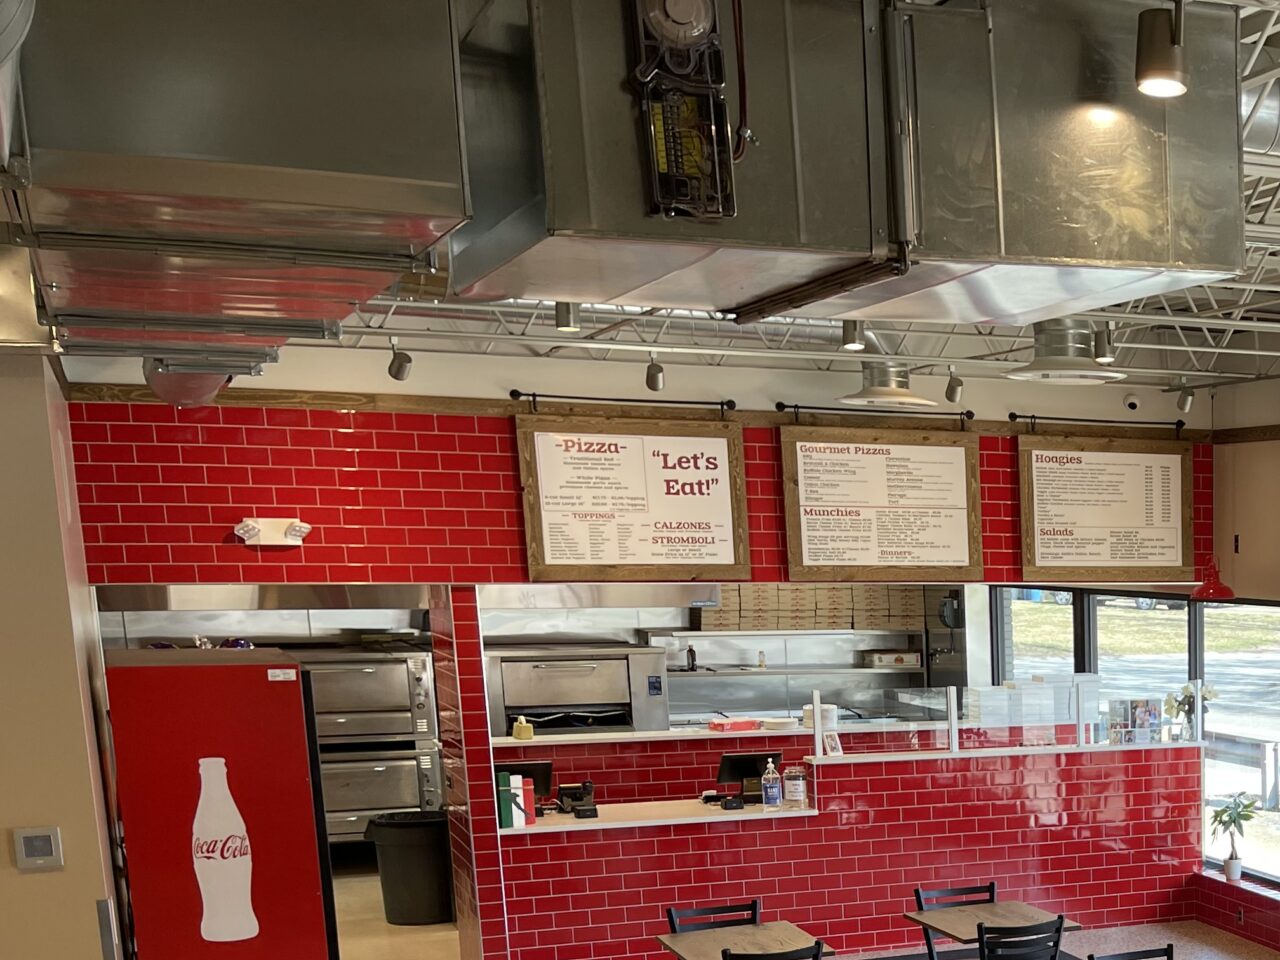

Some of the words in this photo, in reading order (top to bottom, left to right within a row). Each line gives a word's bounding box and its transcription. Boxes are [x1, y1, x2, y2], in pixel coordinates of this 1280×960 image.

[800, 445, 851, 454] Gourmet
[854, 446, 891, 455] Pizzas
[1035, 453, 1082, 466] Hoagies
[803, 507, 861, 517] Munchies
[654, 521, 712, 530] CALZONES
[1040, 528, 1074, 536] Salads
[652, 536, 716, 544] STROMBOLI
[194, 834, 250, 861] Coca-Cola
